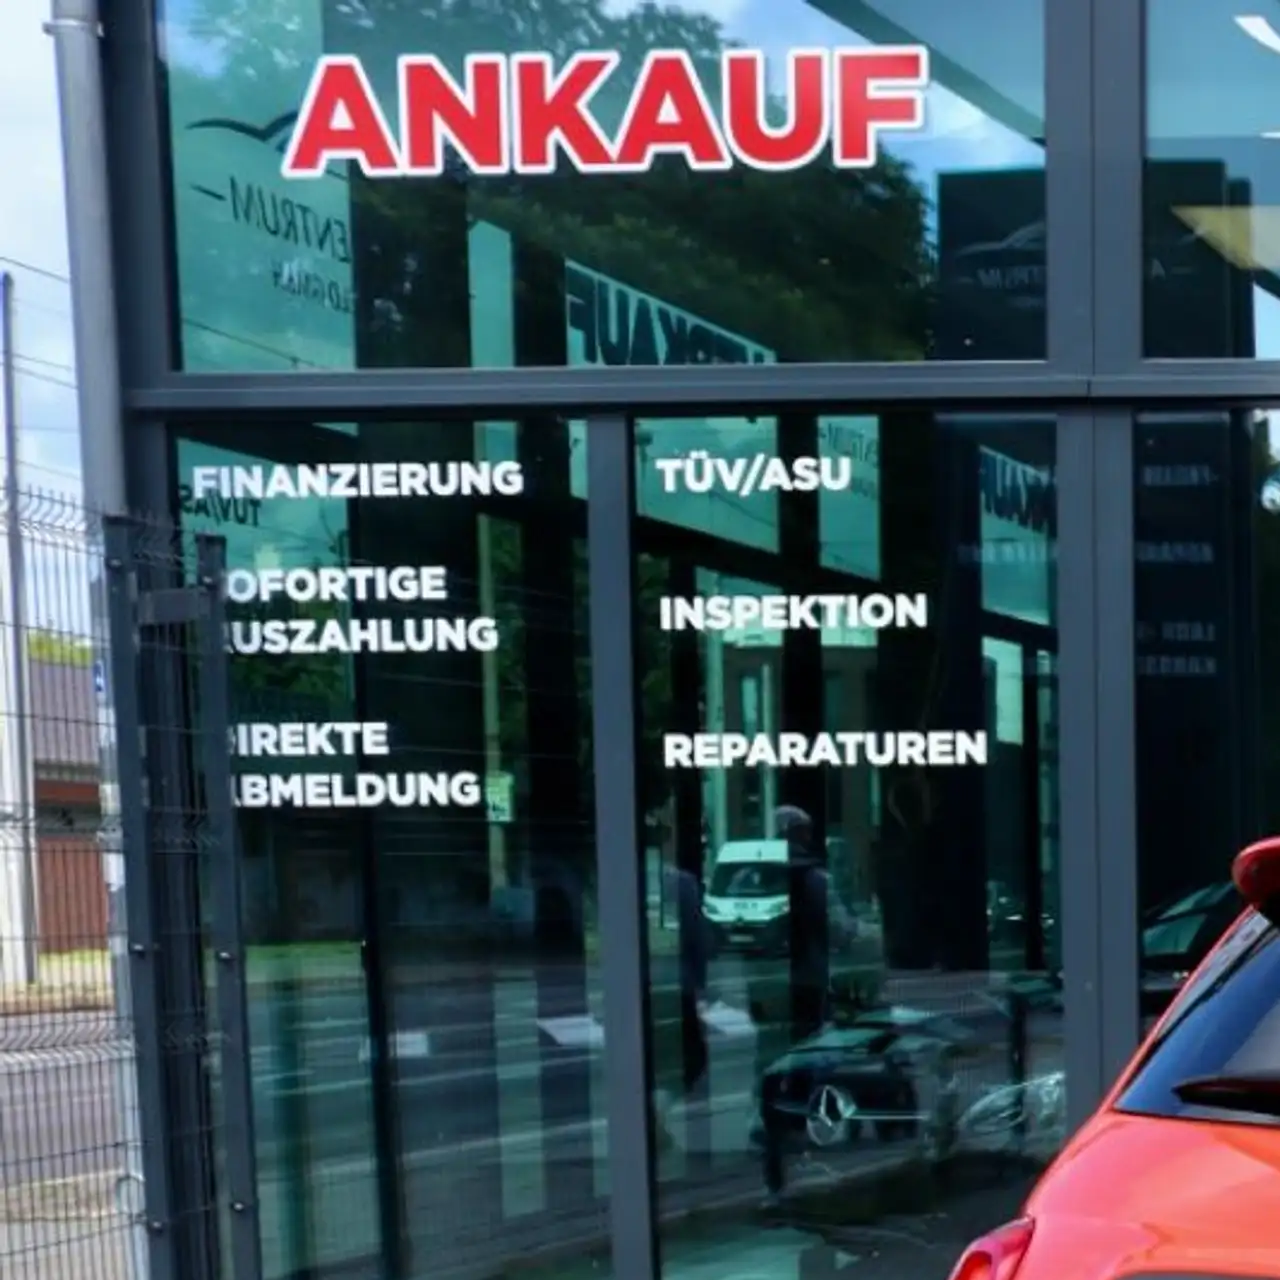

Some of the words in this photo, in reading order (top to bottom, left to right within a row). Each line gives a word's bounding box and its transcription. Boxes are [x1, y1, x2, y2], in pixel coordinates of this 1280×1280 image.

[282, 46, 926, 177] ANKAUF
[192, 460, 524, 499] FINANZIERUNG
[656, 451, 852, 497] TÜV/ASU
[227, 565, 447, 602] OFORTIGE
[660, 593, 927, 630] INSPEKTION
[228, 722, 390, 756] IREKTE
[663, 730, 988, 768] REPARATUREN
